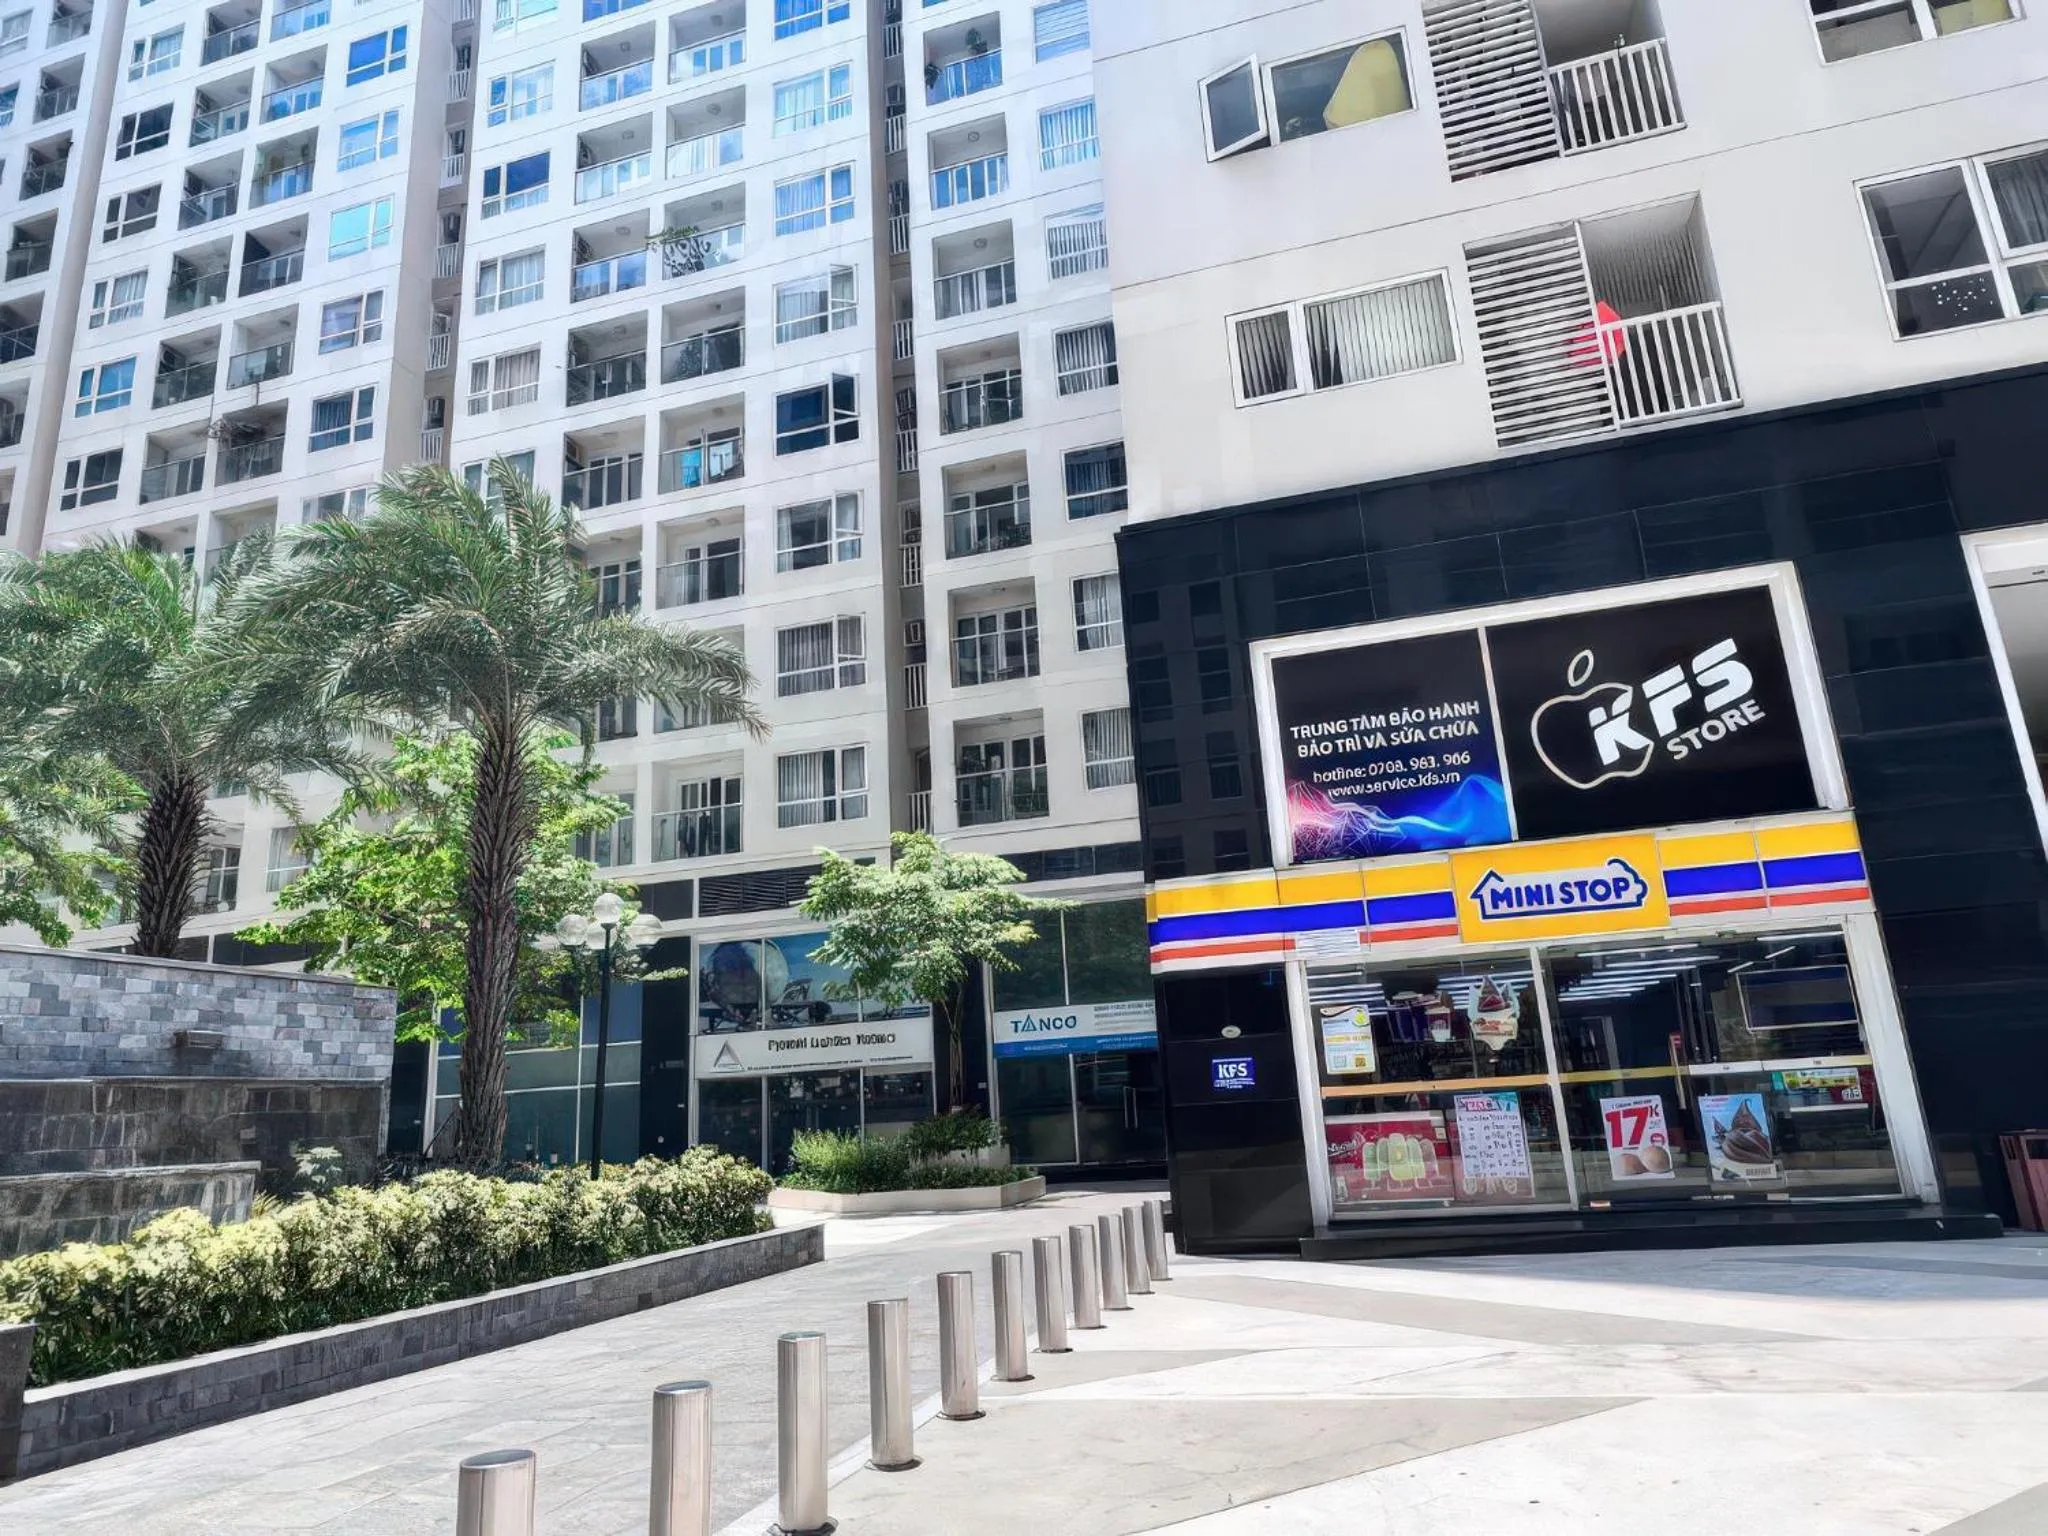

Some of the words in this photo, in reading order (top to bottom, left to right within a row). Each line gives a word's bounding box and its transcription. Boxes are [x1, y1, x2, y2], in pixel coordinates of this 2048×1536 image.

[1588, 637, 1754, 766] KFS
[1290, 719, 1348, 739] TRUNG
[1666, 699, 1766, 760] STORE
[1218, 1062, 1248, 1079] KFS
